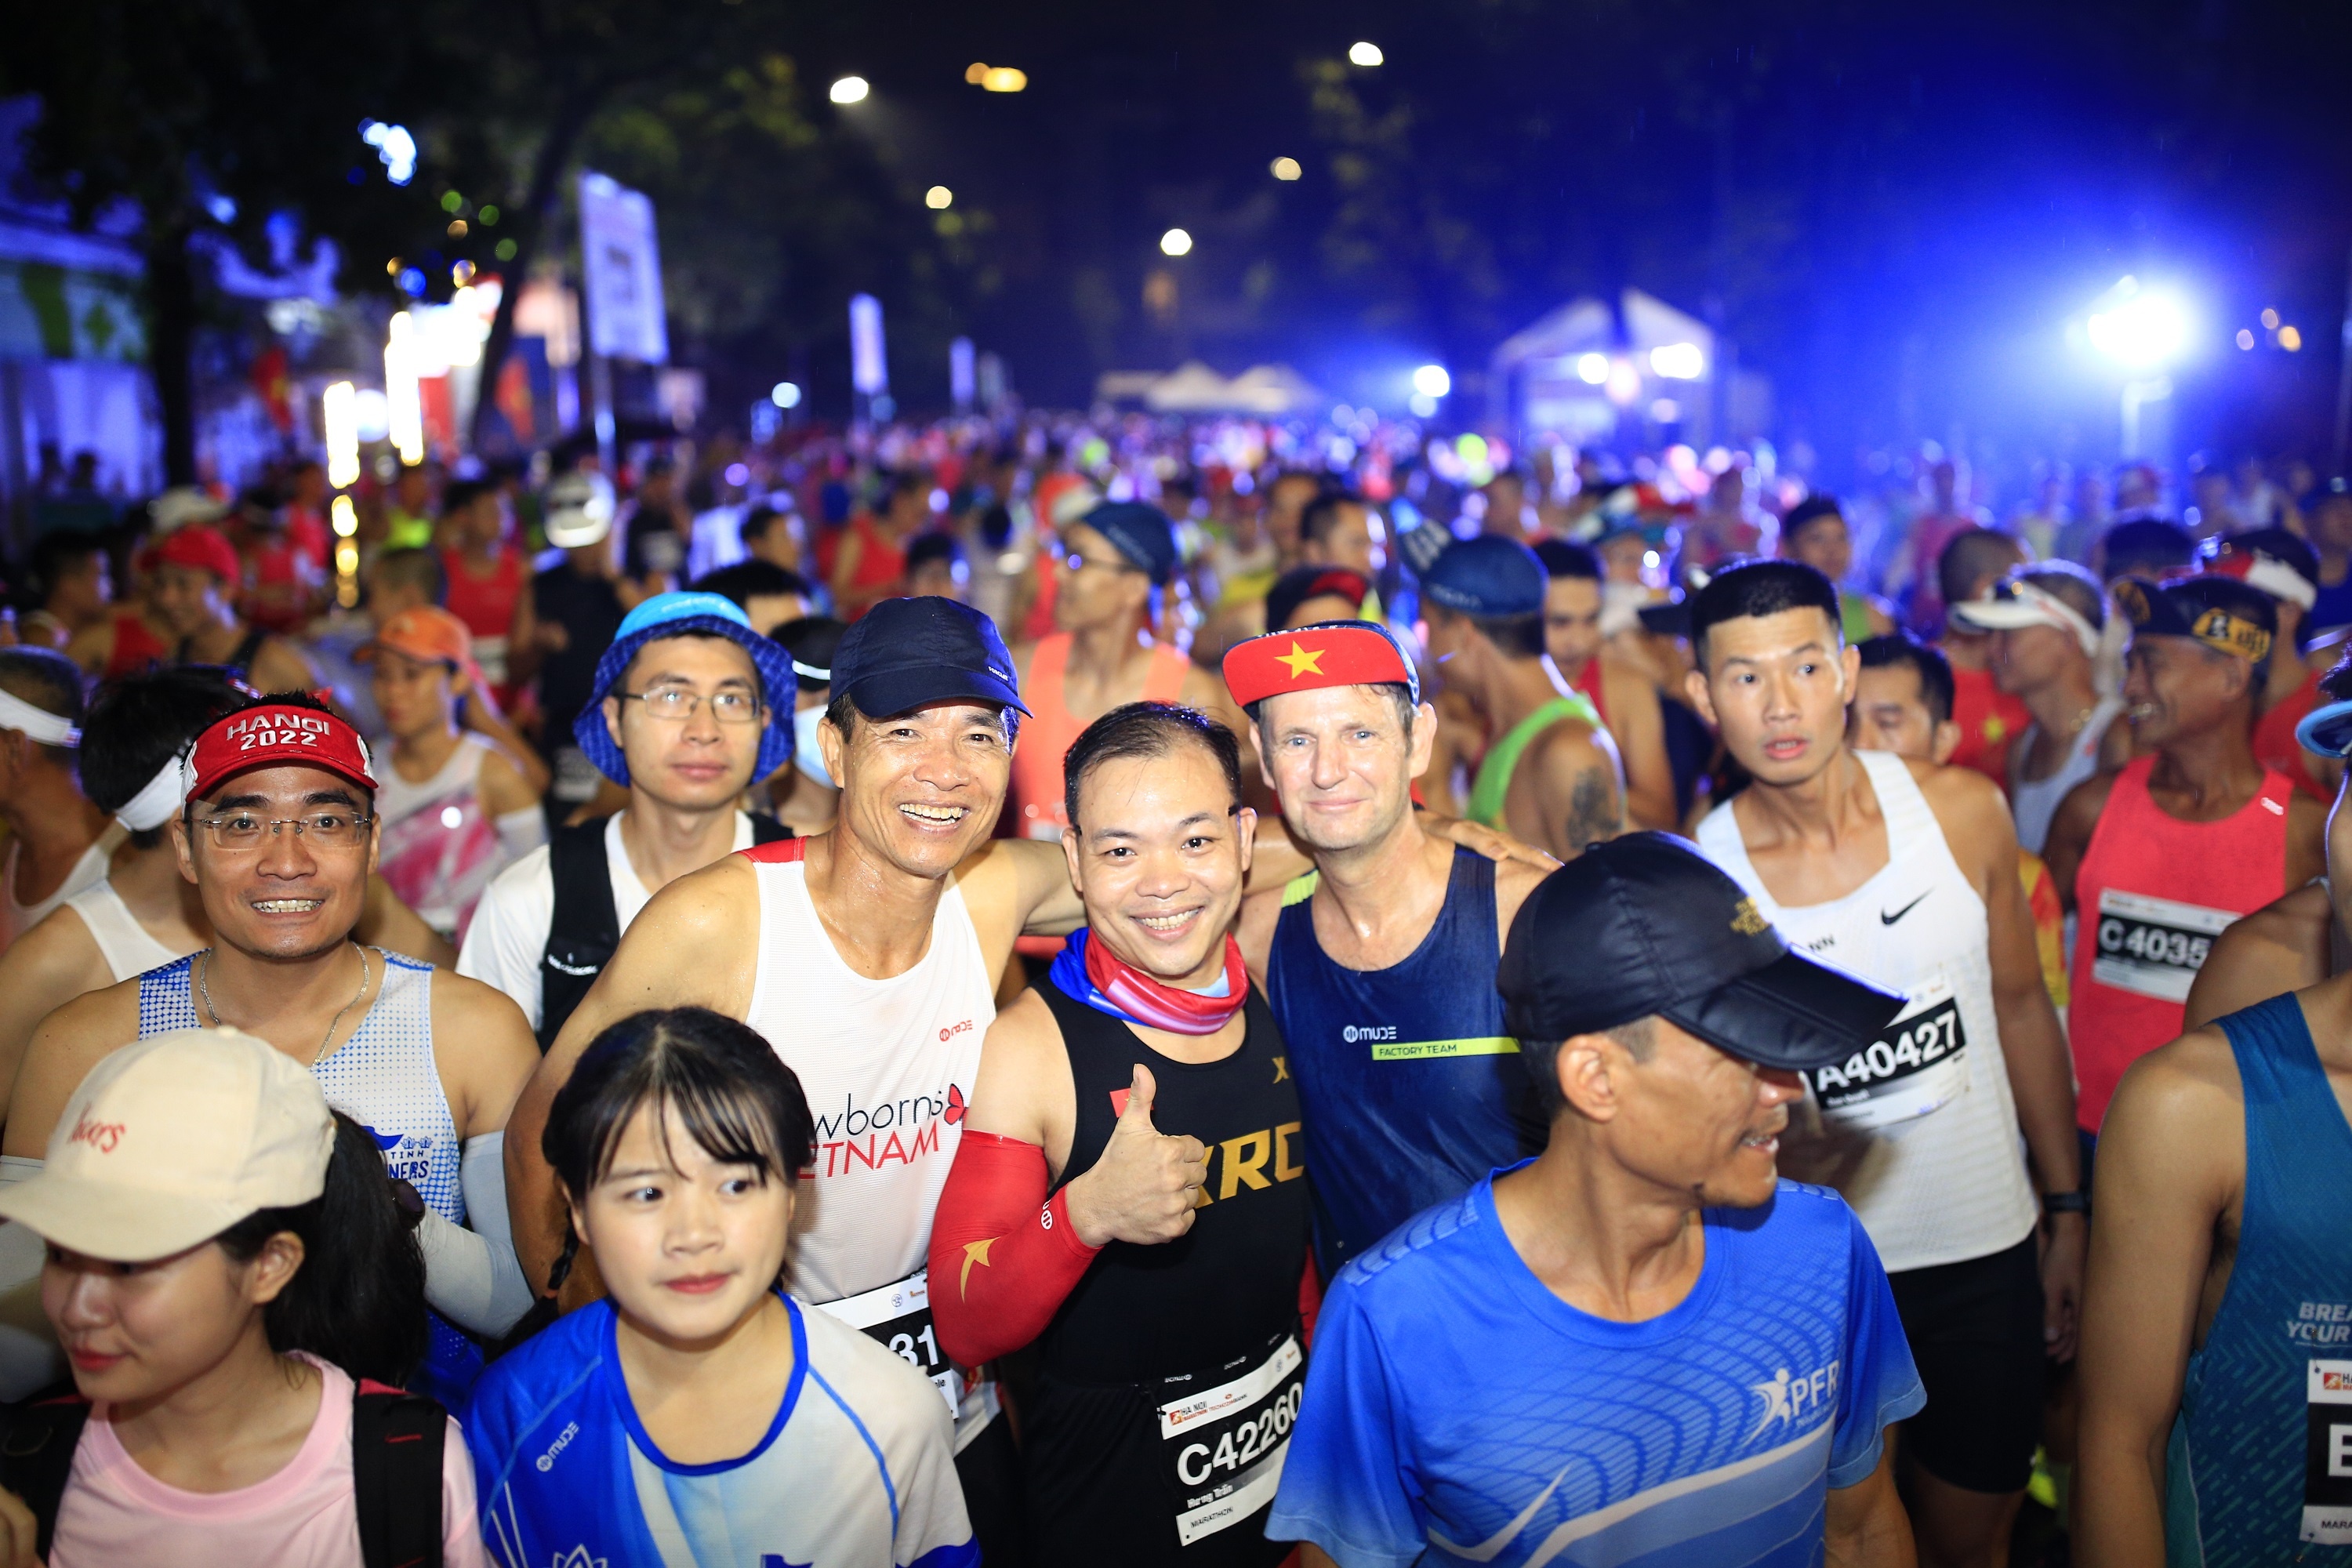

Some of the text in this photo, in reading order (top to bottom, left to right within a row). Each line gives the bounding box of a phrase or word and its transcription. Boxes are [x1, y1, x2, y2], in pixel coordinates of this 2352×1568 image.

[227, 713, 330, 740] HANOI
[240, 729, 318, 750] 2022
[1379, 1044, 1457, 1057] FACTORY TEAM
[1817, 1009, 1956, 1092] A40427
[2286, 1320, 2351, 1343] YOUR
[1177, 1382, 1303, 1486] C42260
